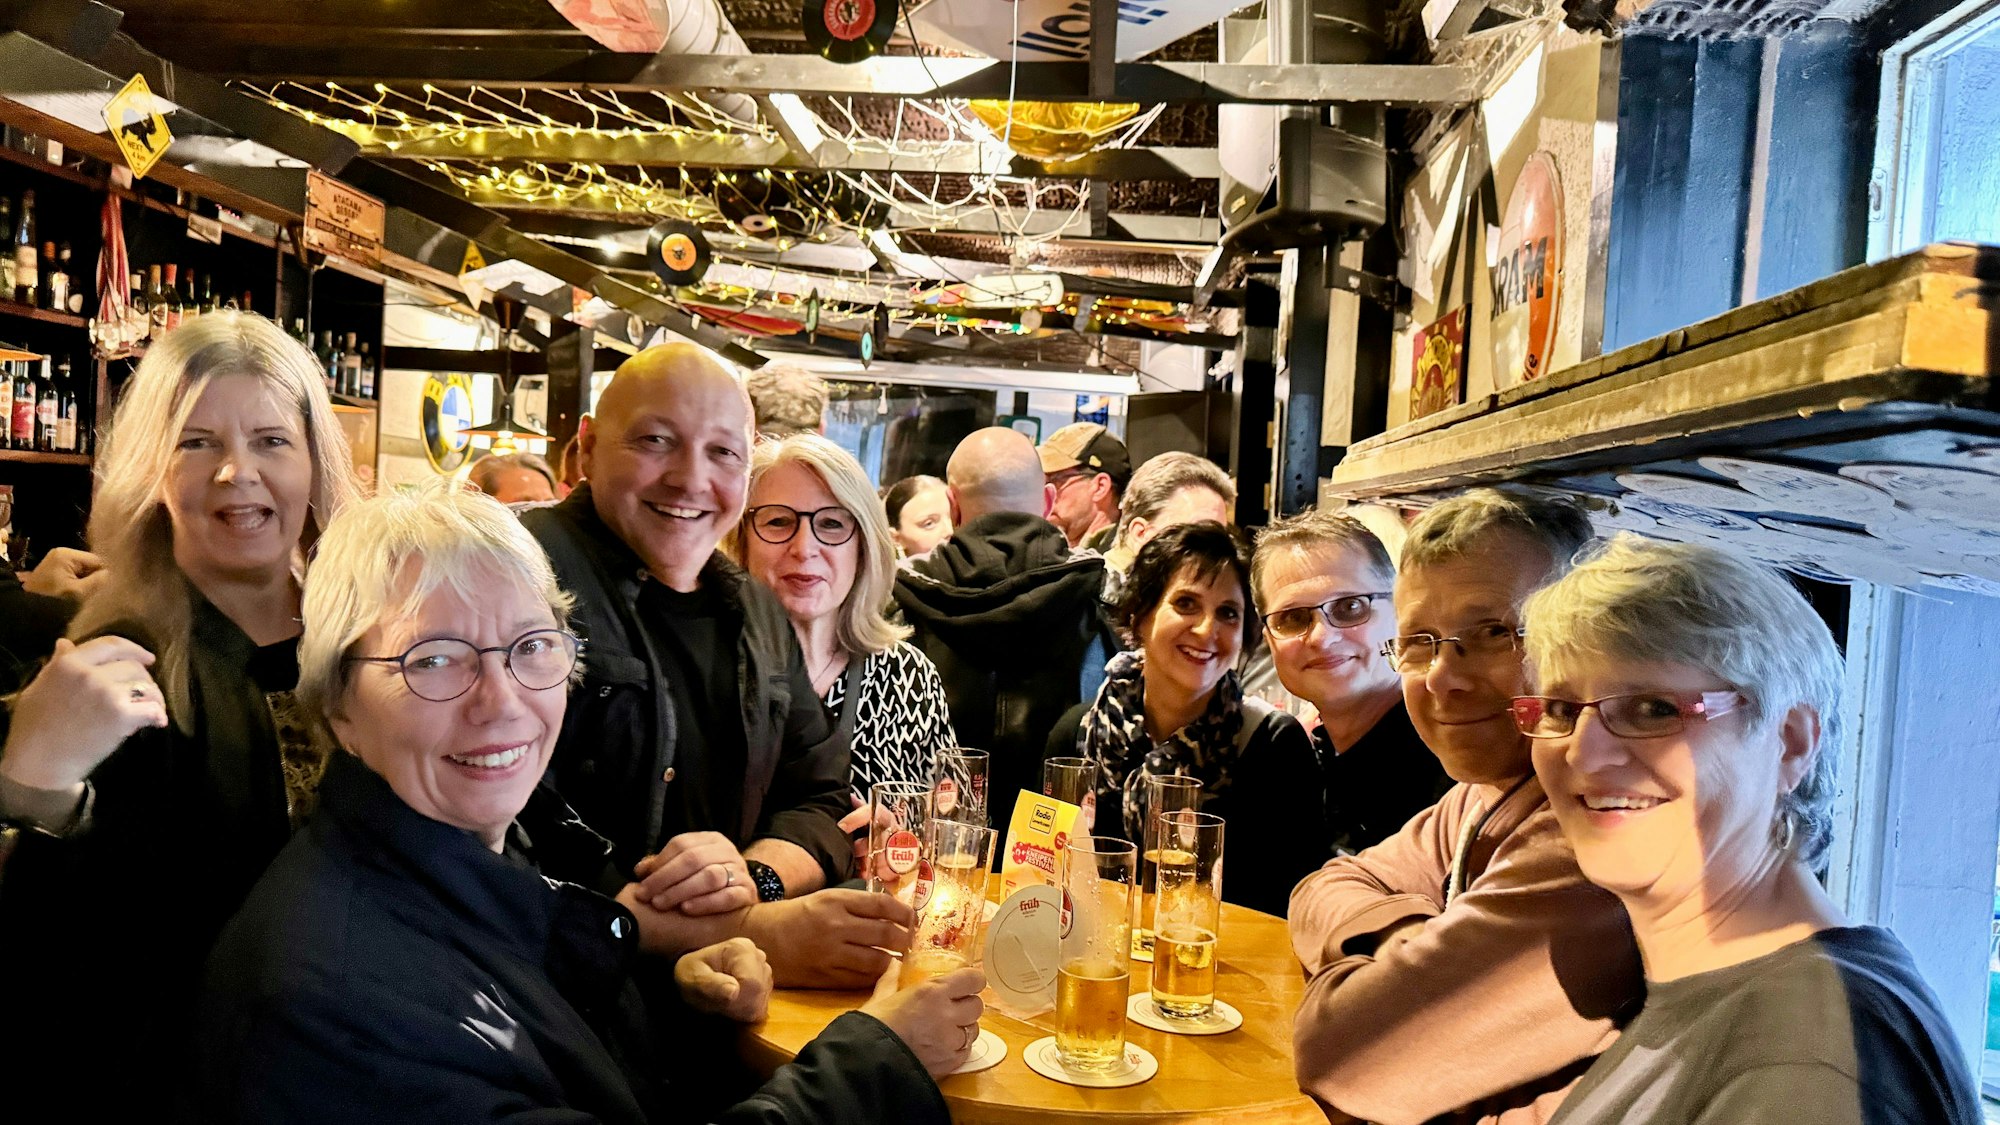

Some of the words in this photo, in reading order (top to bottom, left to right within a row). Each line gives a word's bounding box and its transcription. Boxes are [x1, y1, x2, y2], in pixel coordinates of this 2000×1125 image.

[127, 140, 143, 152] NEXT
[1035, 809, 1052, 821] Radio
[891, 849, 914, 862] früh
[1026, 849, 1054, 864] KNEIPEN
[1026, 856, 1055, 874] FESTIVAL
[1019, 897, 1040, 911] früh
